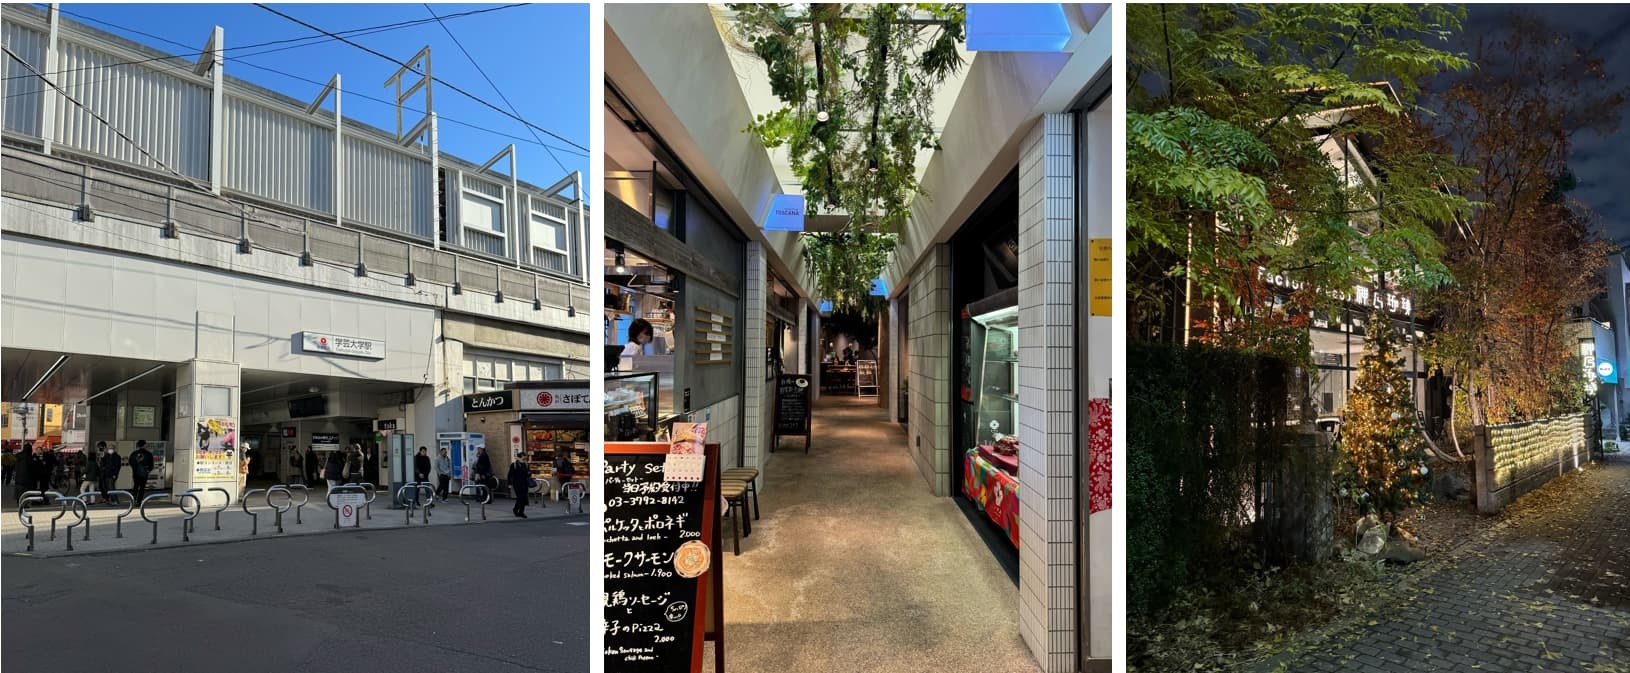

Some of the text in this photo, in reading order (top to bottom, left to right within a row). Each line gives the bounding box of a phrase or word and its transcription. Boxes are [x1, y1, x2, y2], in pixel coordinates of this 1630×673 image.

[335, 338, 372, 350] 学芸大学駅
[471, 396, 504, 408] とんかつ
[563, 394, 590, 404] さぼて
[608, 496, 685, 508] 03-3792-8142
